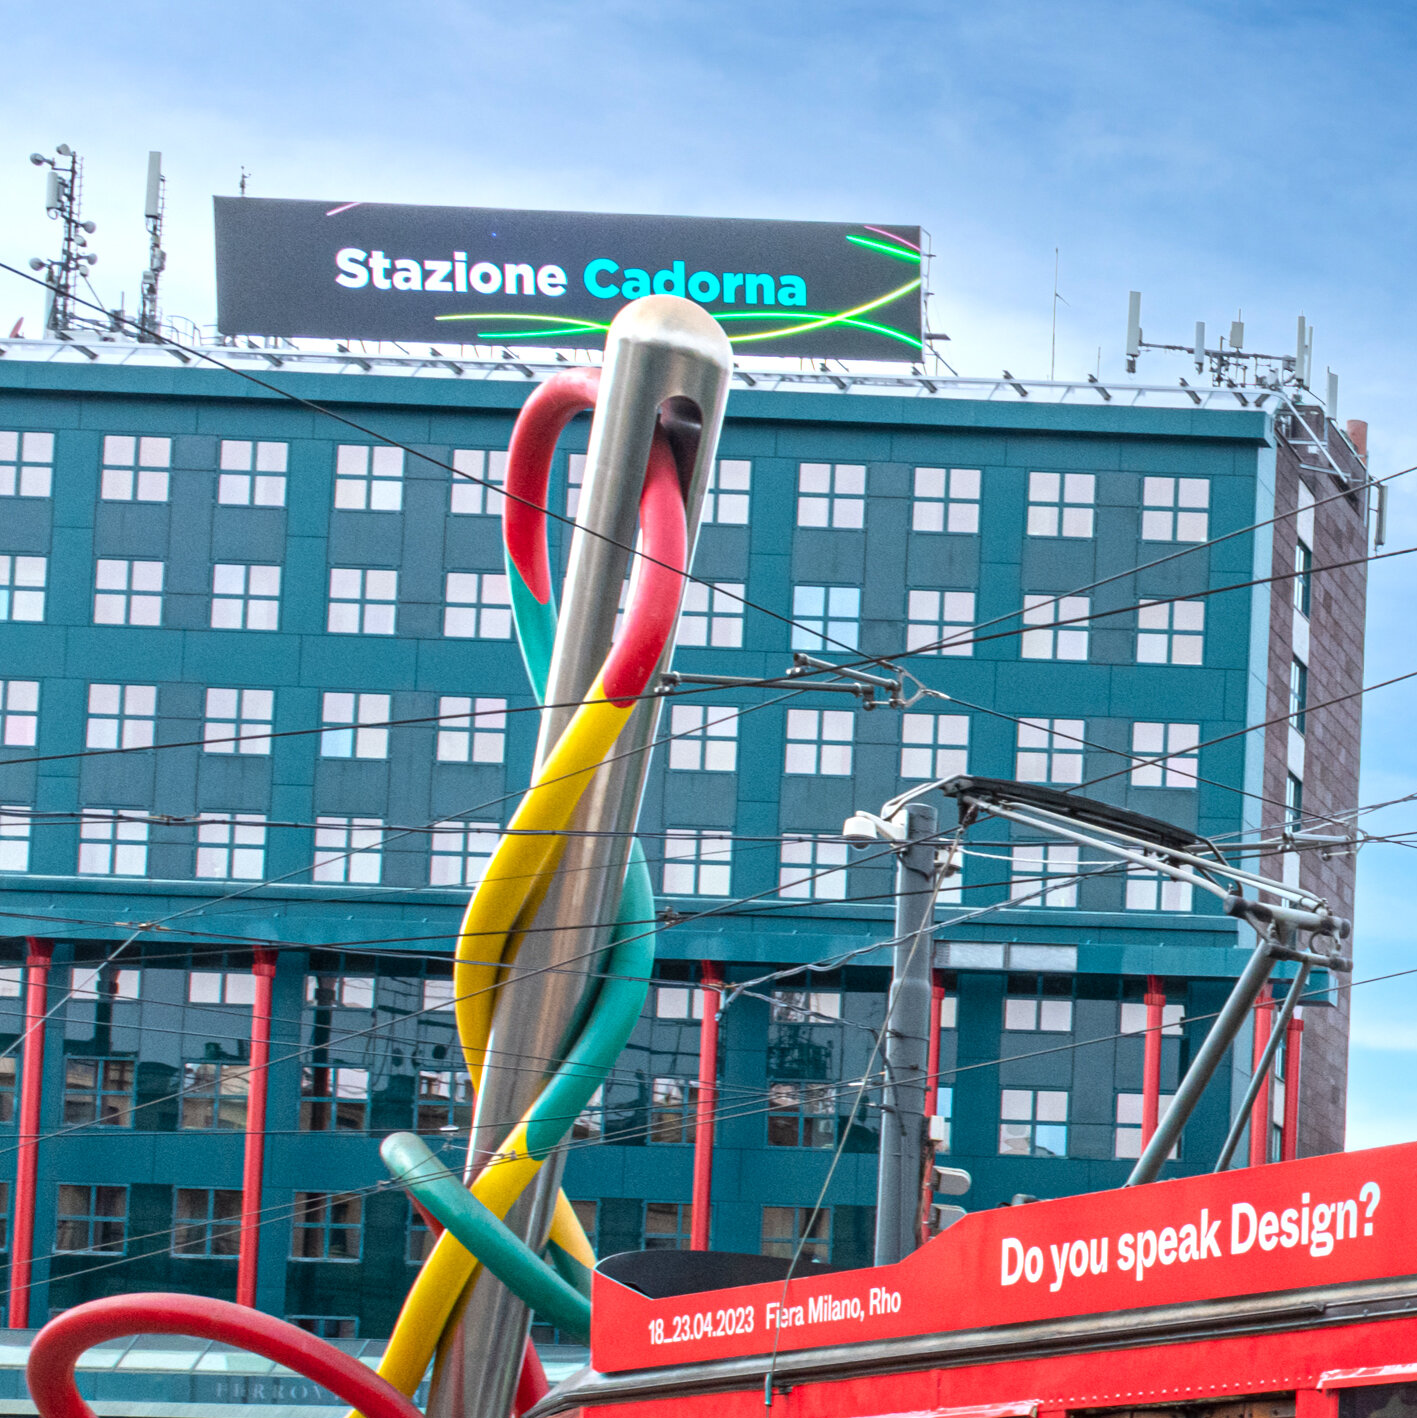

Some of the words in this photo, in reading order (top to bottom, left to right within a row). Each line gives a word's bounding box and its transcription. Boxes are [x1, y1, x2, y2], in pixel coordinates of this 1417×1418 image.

[335, 247, 568, 296] Stazione
[583, 257, 808, 306] Cadorna
[1001, 1237, 1044, 1286] Do
[1050, 1237, 1109, 1292] you
[1117, 1208, 1222, 1281] speak
[1231, 1181, 1382, 1258] Design?
[648, 1305, 754, 1345] 18_23.04.2023
[766, 1301, 805, 1330] Fiera
[808, 1295, 866, 1324] Milano,
[870, 1287, 901, 1316] Rho
